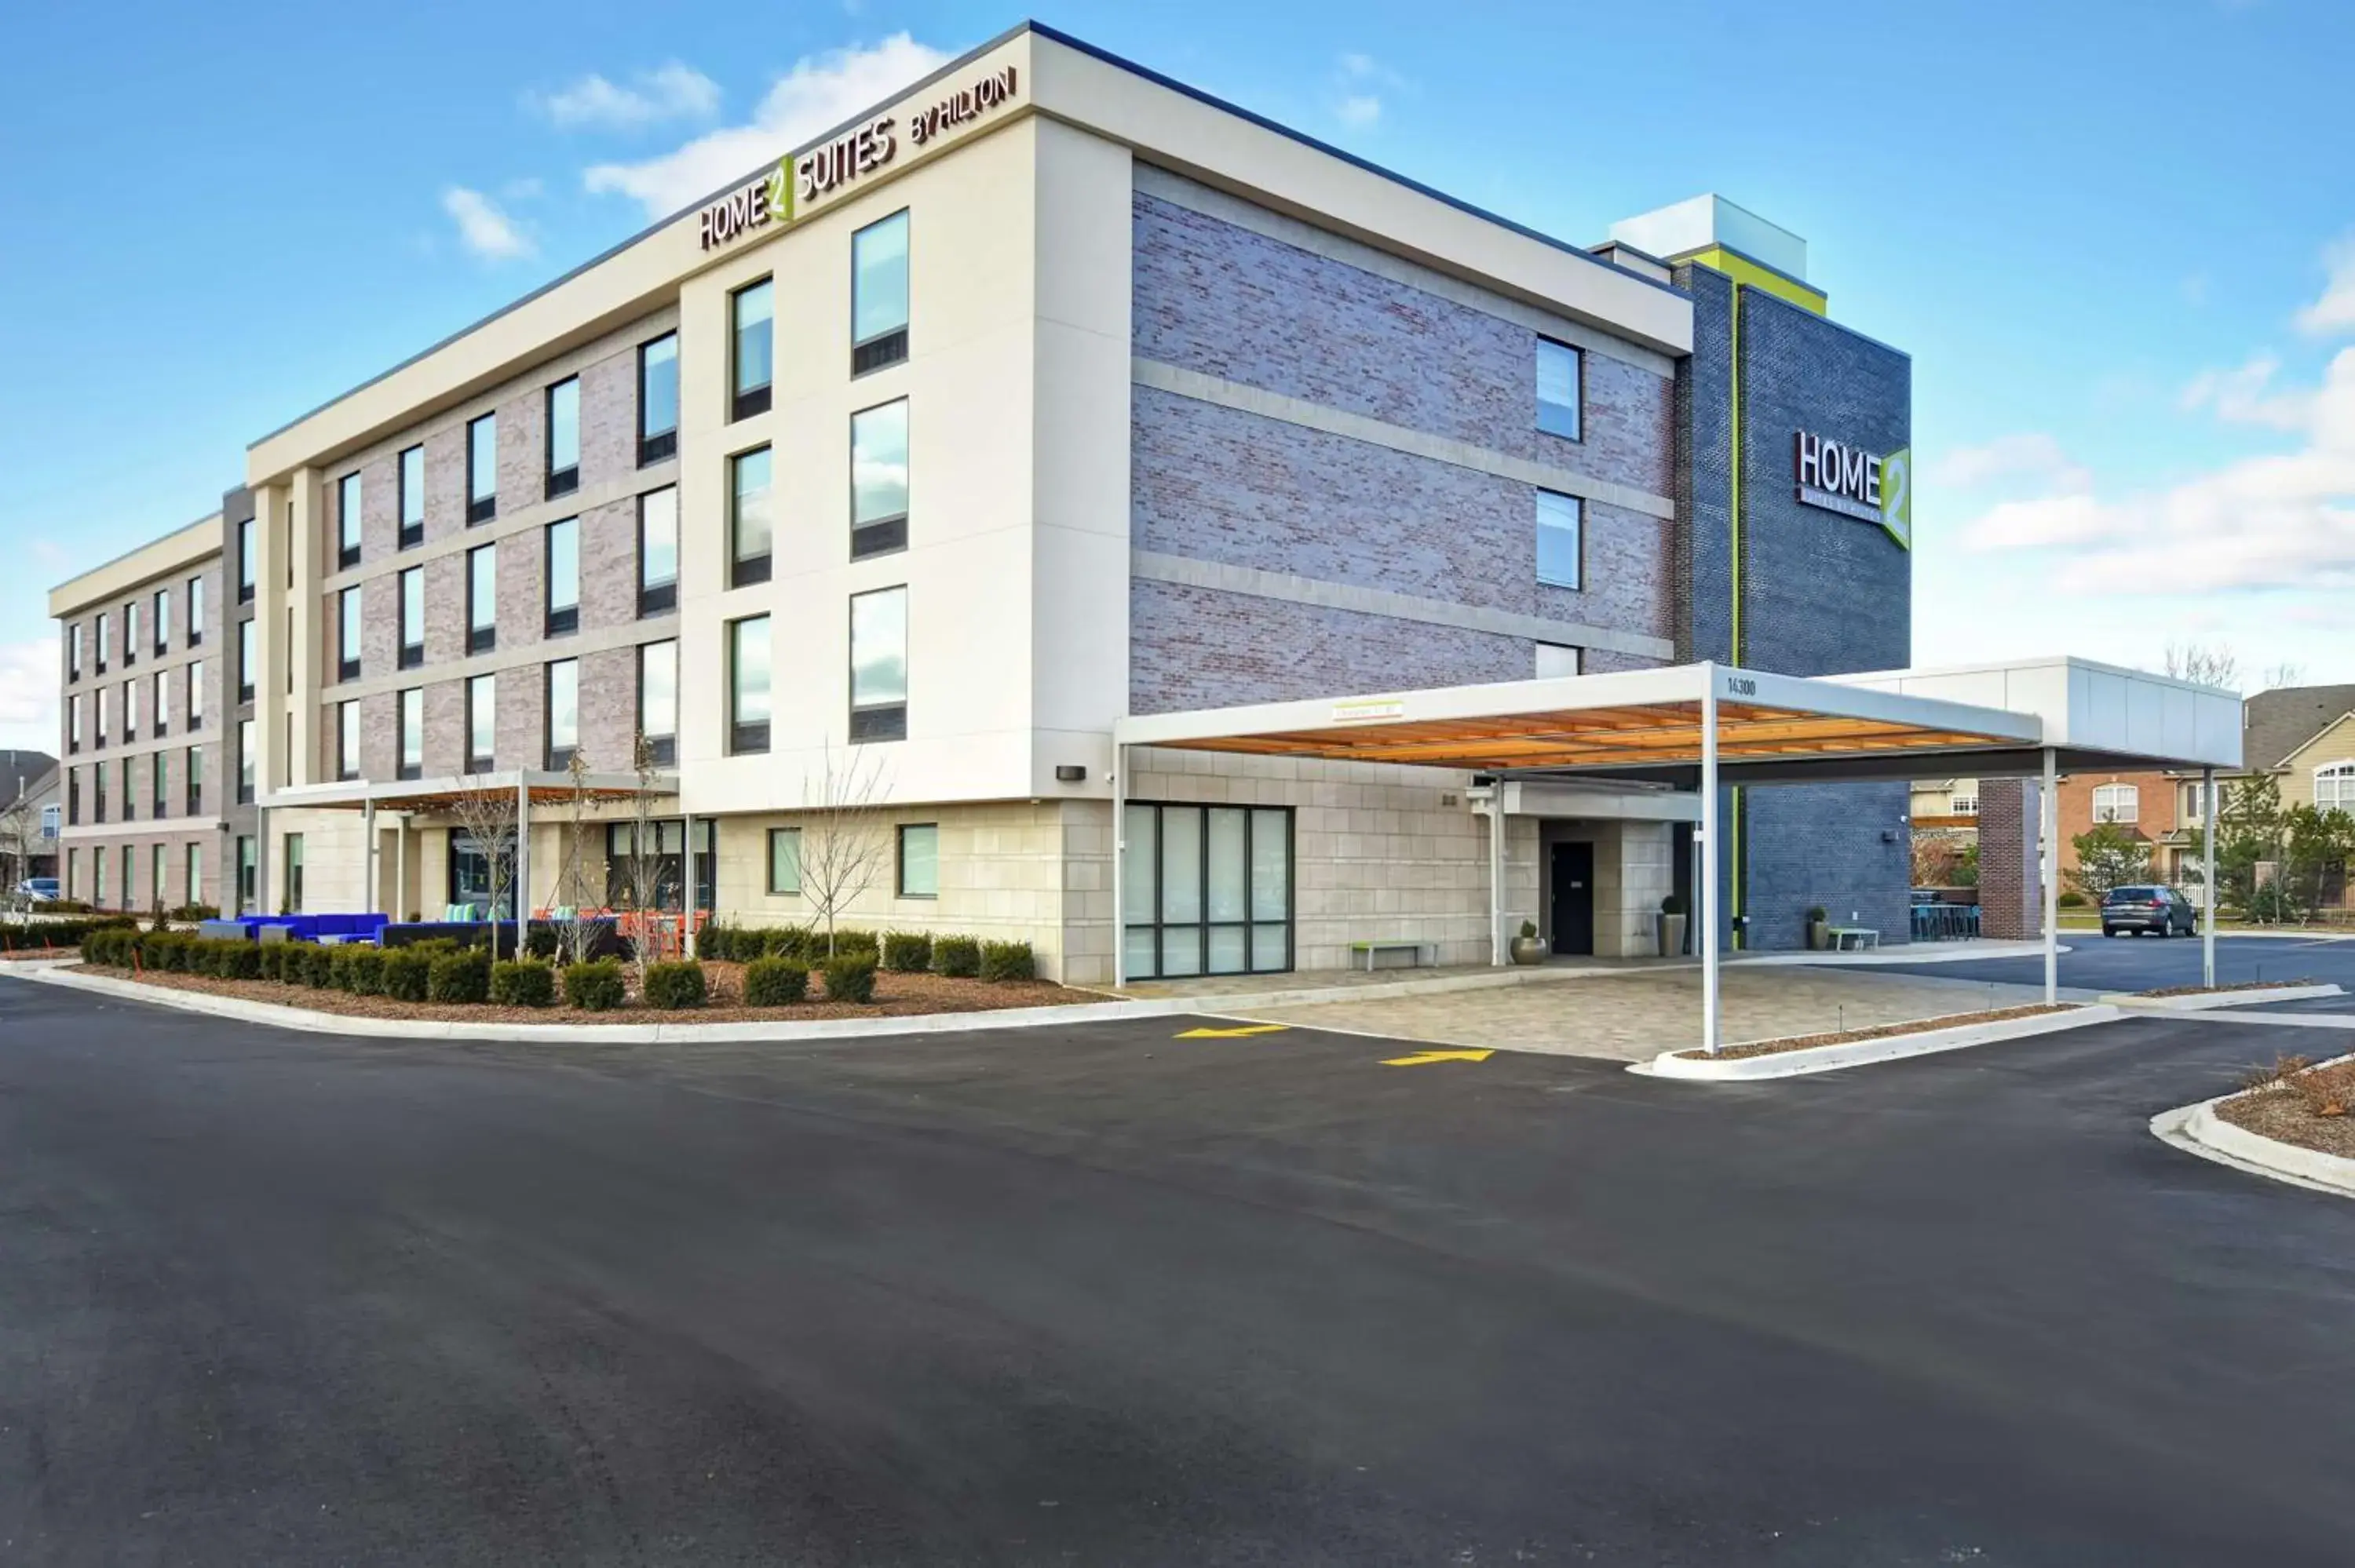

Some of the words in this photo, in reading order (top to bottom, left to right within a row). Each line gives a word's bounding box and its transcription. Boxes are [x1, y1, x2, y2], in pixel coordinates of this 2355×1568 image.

[797, 117, 894, 201] SUITES
[911, 107, 938, 144] BY
[938, 66, 1016, 129] HILTON
